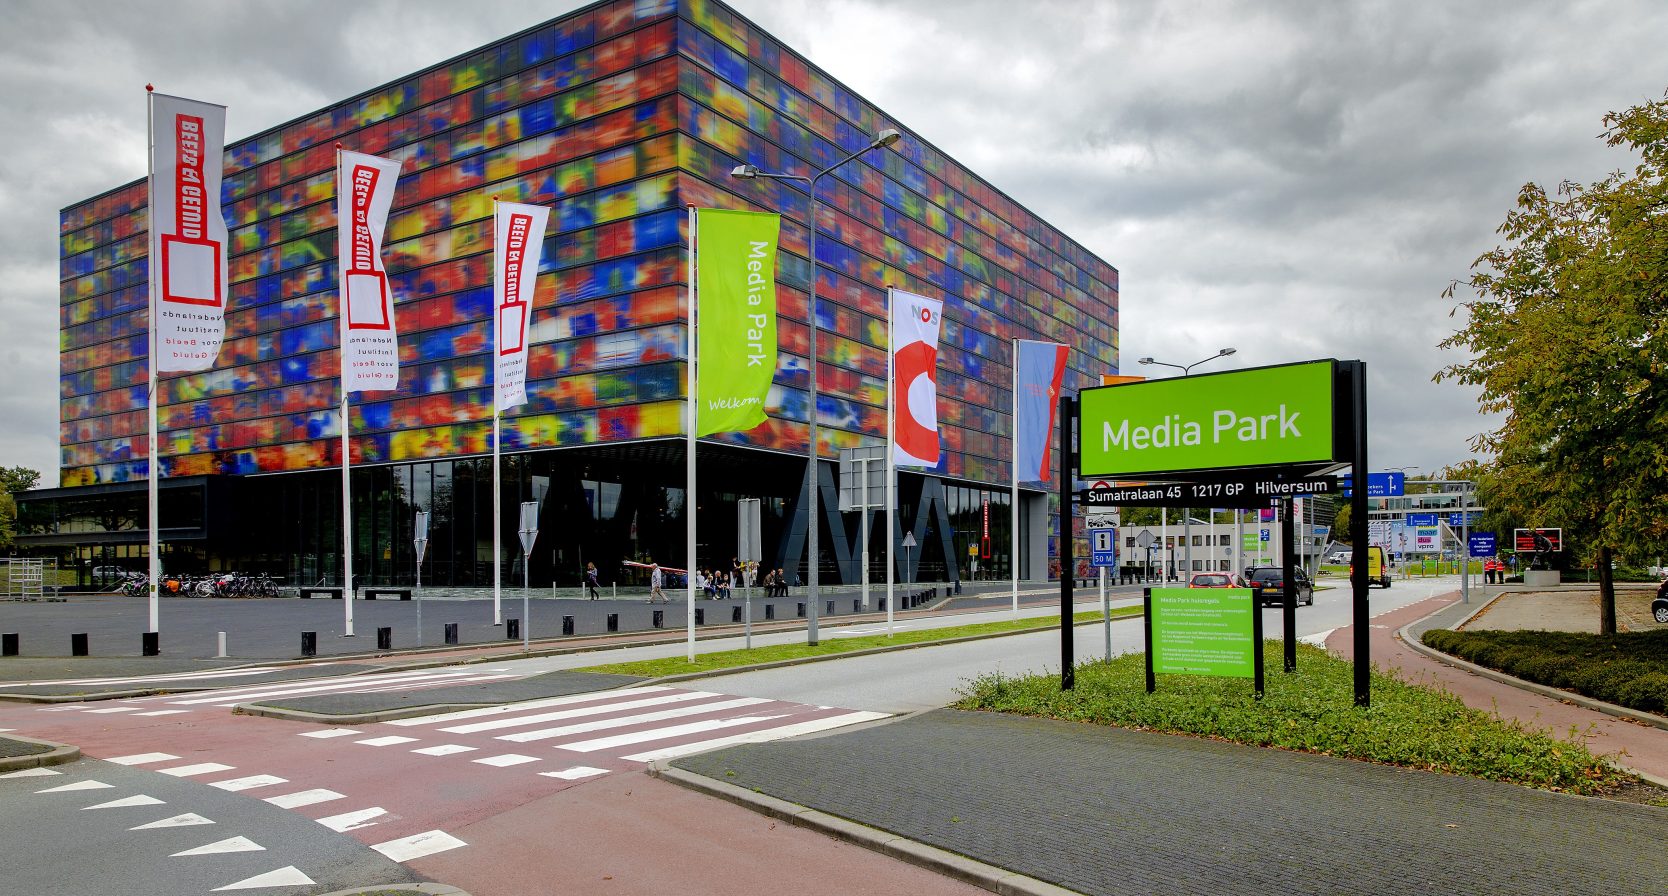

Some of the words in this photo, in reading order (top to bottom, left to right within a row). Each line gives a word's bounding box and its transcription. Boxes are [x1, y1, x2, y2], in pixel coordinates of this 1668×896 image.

[747, 241, 768, 306] Media
[911, 304, 938, 326] NOS
[747, 313, 767, 366] Park
[708, 395, 762, 411] Welkom
[1103, 414, 1201, 452] Media
[1213, 404, 1302, 444] Park
[1088, 489, 1164, 503] Sumatralaan
[1166, 486, 1181, 499] 45
[1191, 484, 1222, 498] 1217
[1225, 483, 1244, 496] GP
[1255, 480, 1328, 495] Hilversum
[1095, 555, 1104, 563] 50
